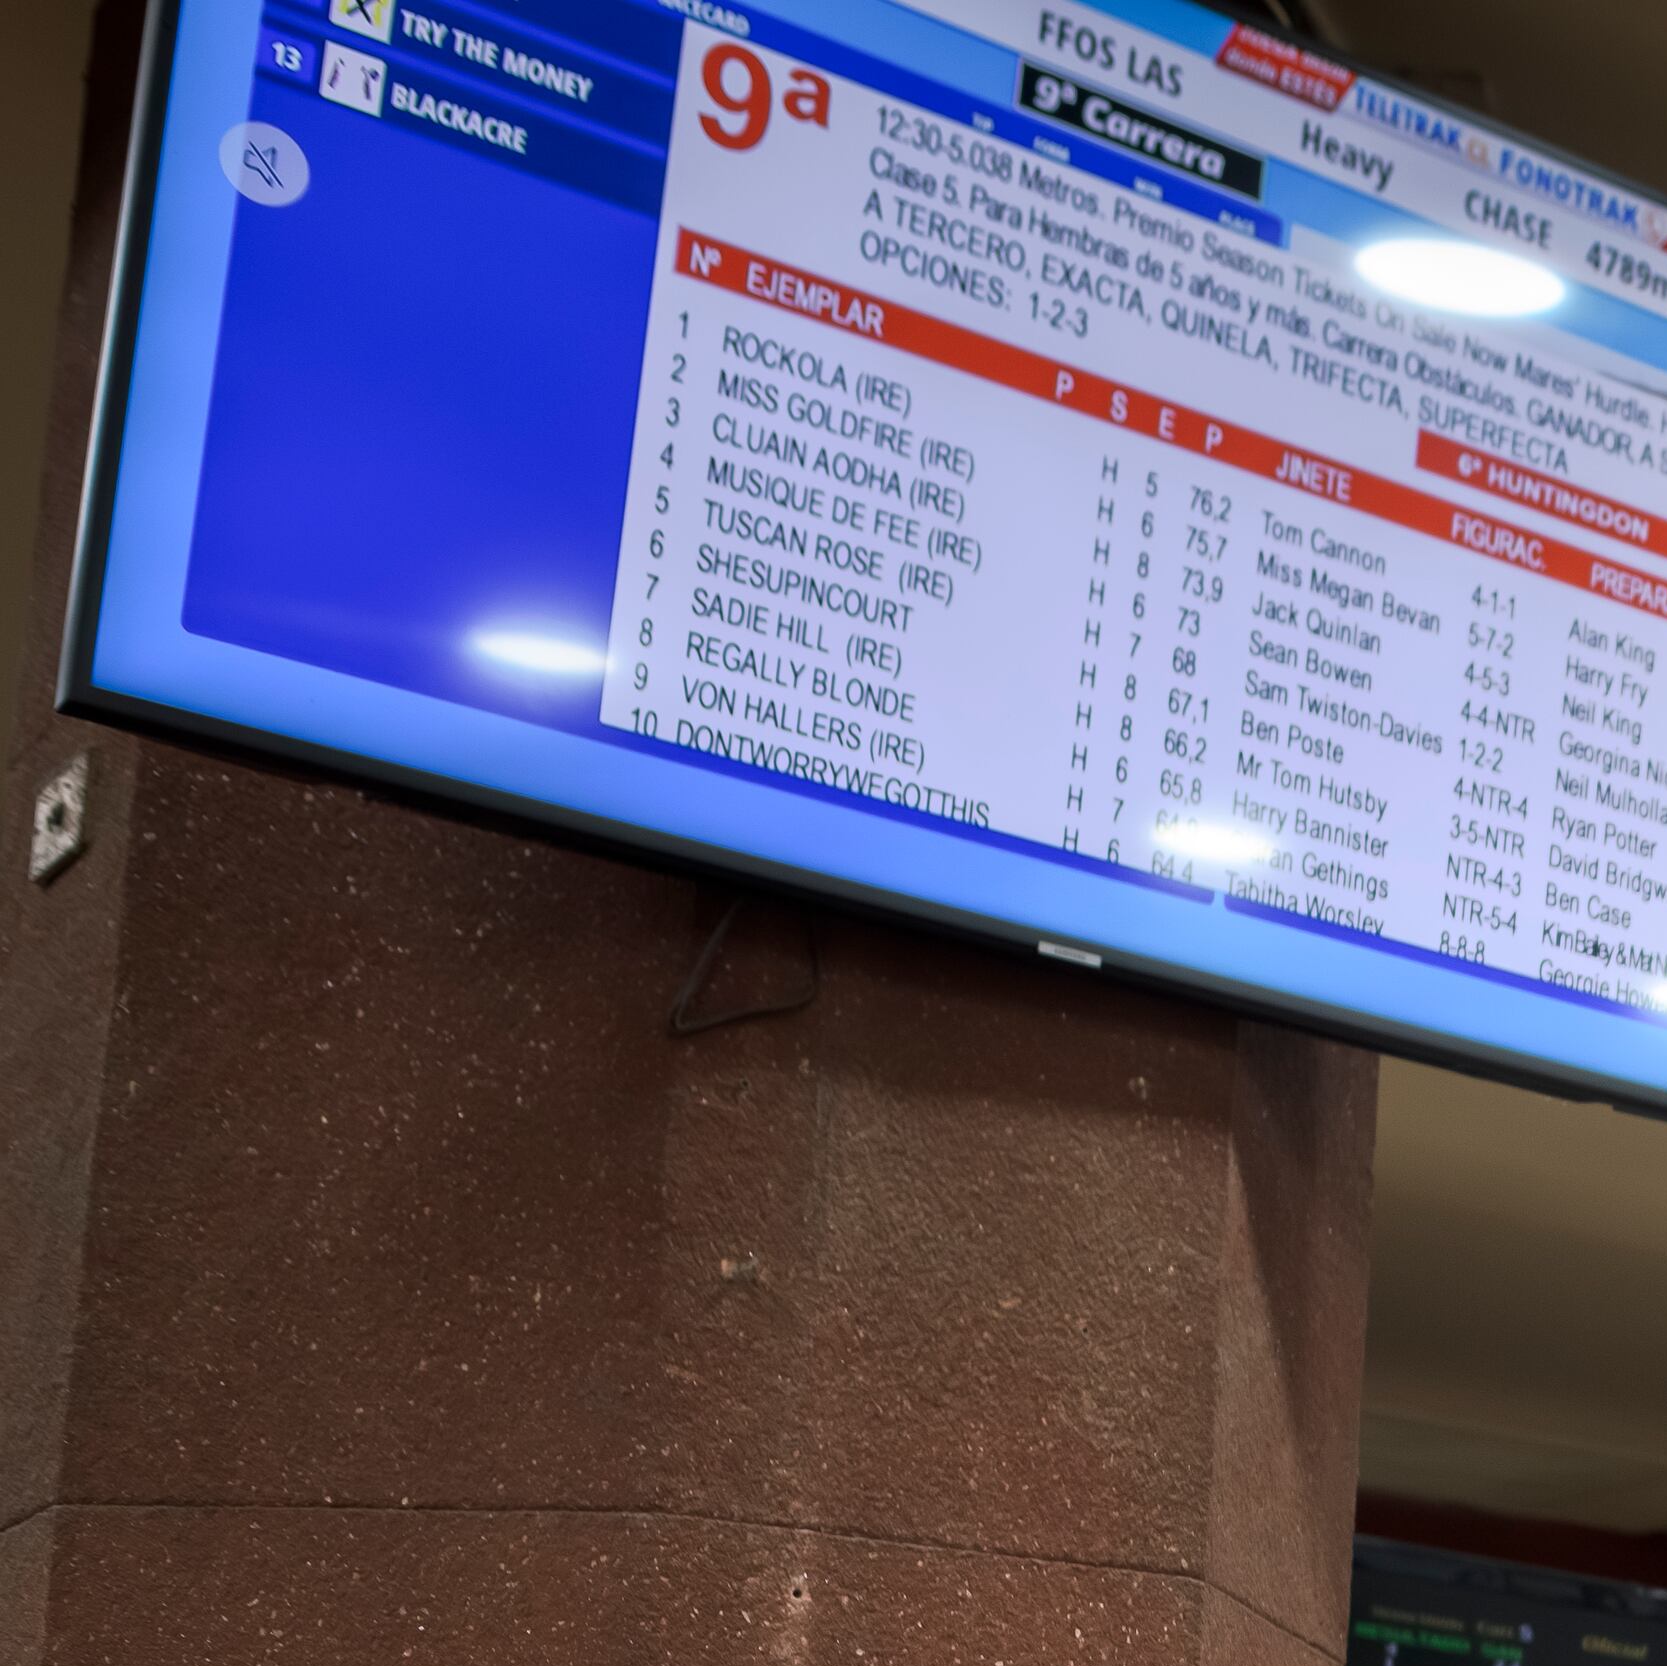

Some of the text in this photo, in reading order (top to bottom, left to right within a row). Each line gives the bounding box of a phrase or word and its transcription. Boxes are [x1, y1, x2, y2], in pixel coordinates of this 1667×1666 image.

[271, 41, 526, 153] 13 BLACKACRE
[401, 9, 592, 101] TRY THE MONEY
[1039, 10, 1114, 69] FFOS
[1128, 47, 1181, 96] LAS
[1301, 120, 1393, 192] Heavy
[1464, 189, 1551, 247] CHASE
[1084, 98, 1223, 177] Carrera
[1352, 79, 1635, 229] TELETRAK FONOTRAK
[747, 262, 883, 336] EJEMPLAR
[1056, 371, 1073, 398] P
[1111, 391, 1127, 421] S
[1159, 408, 1174, 439] E
[1206, 424, 1222, 451] P
[1276, 453, 1350, 500] JINETE
[860, 230, 1088, 338] OPCIONES: 1-2-3
[863, 189, 1567, 473] A TERCERO, EXACTA, QUINELA, TRIFECTA, SUPERFECTA
[869, 147, 937, 197] Clase
[969, 184, 1022, 230] Para
[1028, 207, 1129, 269] Hembras
[1135, 251, 1164, 282] de
[1188, 275, 1240, 312] años
[1322, 320, 1398, 372] Carrera
[878, 105, 1012, 183] 12:30-5.038
[1018, 157, 1109, 221] Metros.
[1113, 197, 1194, 252] Premio
[1202, 231, 1284, 287] Season
[1294, 266, 1369, 319] Tickets
[1463, 336, 1508, 372] Now
[1585, 382, 1649, 428] Hurdle.
[660, 443, 673, 469] 4
[707, 456, 824, 517] MUSIQUE
[832, 496, 865, 531] DE
[874, 509, 919, 548] FEE
[928, 528, 981, 572] (IRE)
[1178, 607, 1200, 636] 73
[1249, 630, 1297, 667] Sean
[1305, 648, 1371, 691] Bowen
[1461, 700, 1535, 743] 4-4-NTR
[1559, 731, 1640, 778] Georgina
[666, 397, 1641, 746] 3 CLUAIN AODHA (IRE) 73,9 Jack Quinlan 4-5-3 Neil King
[671, 354, 1647, 708] 2 MISS GOLDFIRE (IRE) 75,7 Miss Megan Bevan 5-7-2 Harry Fry
[679, 311, 1655, 673] 1 ROCKOLA (IRE) 76,2 Tom Cannon 4-1-1 Alan King
[1488, 464, 1648, 541] HUNTINGDON
[639, 618, 653, 647] 8
[686, 631, 805, 688] REGALLY
[812, 667, 914, 722] BLONDE
[1160, 769, 1201, 803] 65,8
[1233, 789, 1287, 833] Harry
[1295, 808, 1388, 857] Bannister
[1447, 853, 1520, 896] NTR-4-3
[1545, 881, 1579, 913] Ben
[1587, 895, 1631, 929] Case
[646, 573, 659, 599] 7
[692, 588, 768, 634] SADIE
[776, 612, 828, 653] HILL
[846, 635, 901, 678] (IRE)
[1164, 728, 1206, 763] 66,2
[1237, 750, 1262, 778] Mr
[1271, 759, 1310, 794] Tom
[1319, 775, 1387, 822] Hutsby
[1450, 814, 1524, 858] 3-5-NTR
[1549, 844, 1598, 880] David
[650, 529, 1656, 858] 6 SHESUPINCOURT 67,1 Ben Poste 4-NTR-4 Ryan Potter
[655, 485, 669, 514] 5
[705, 499, 806, 556] TUSCAN
[815, 534, 883, 580] ROSE
[899, 562, 953, 606] (IRE)
[1172, 647, 1195, 676] 68
[1245, 670, 1287, 705] Sam
[1298, 685, 1441, 753] Twiston-Davies
[1460, 738, 1503, 772] 1-2-2
[1556, 768, 1588, 799] Neil
[634, 663, 1516, 934] 9 VON HALLERS (IRE) Gethings NTR-5-4
